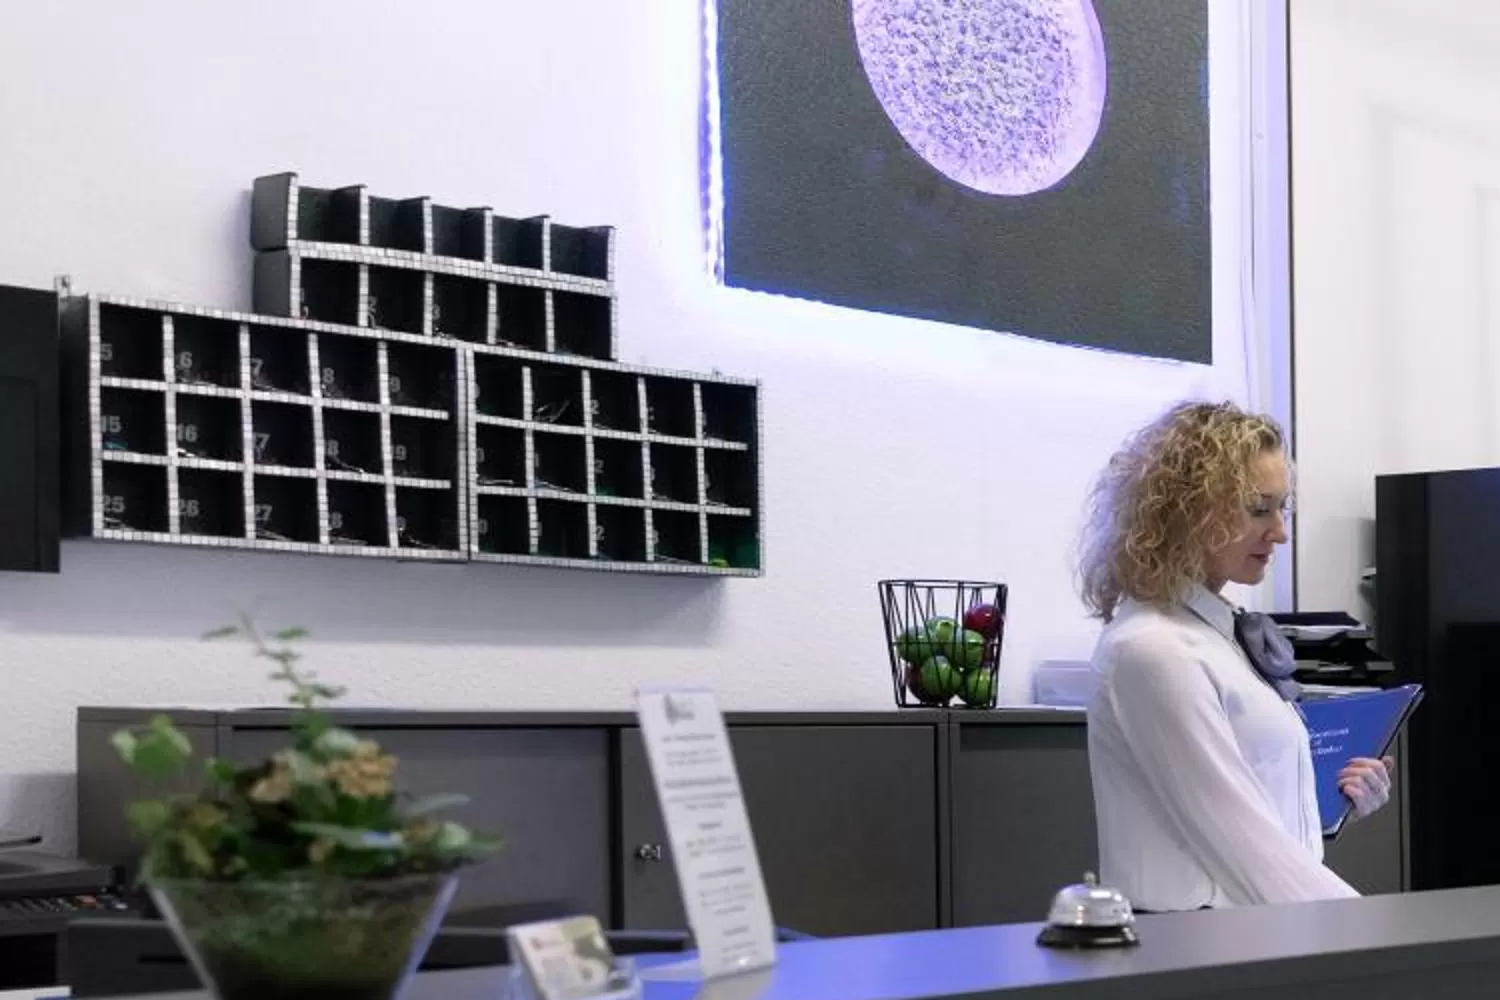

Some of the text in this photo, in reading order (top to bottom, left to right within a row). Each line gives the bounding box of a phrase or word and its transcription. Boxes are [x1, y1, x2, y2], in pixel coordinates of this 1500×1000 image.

[100, 343, 113, 361] 5
[180, 351, 193, 369] 6
[251, 357, 264, 376] 7
[322, 367, 335, 384] 8
